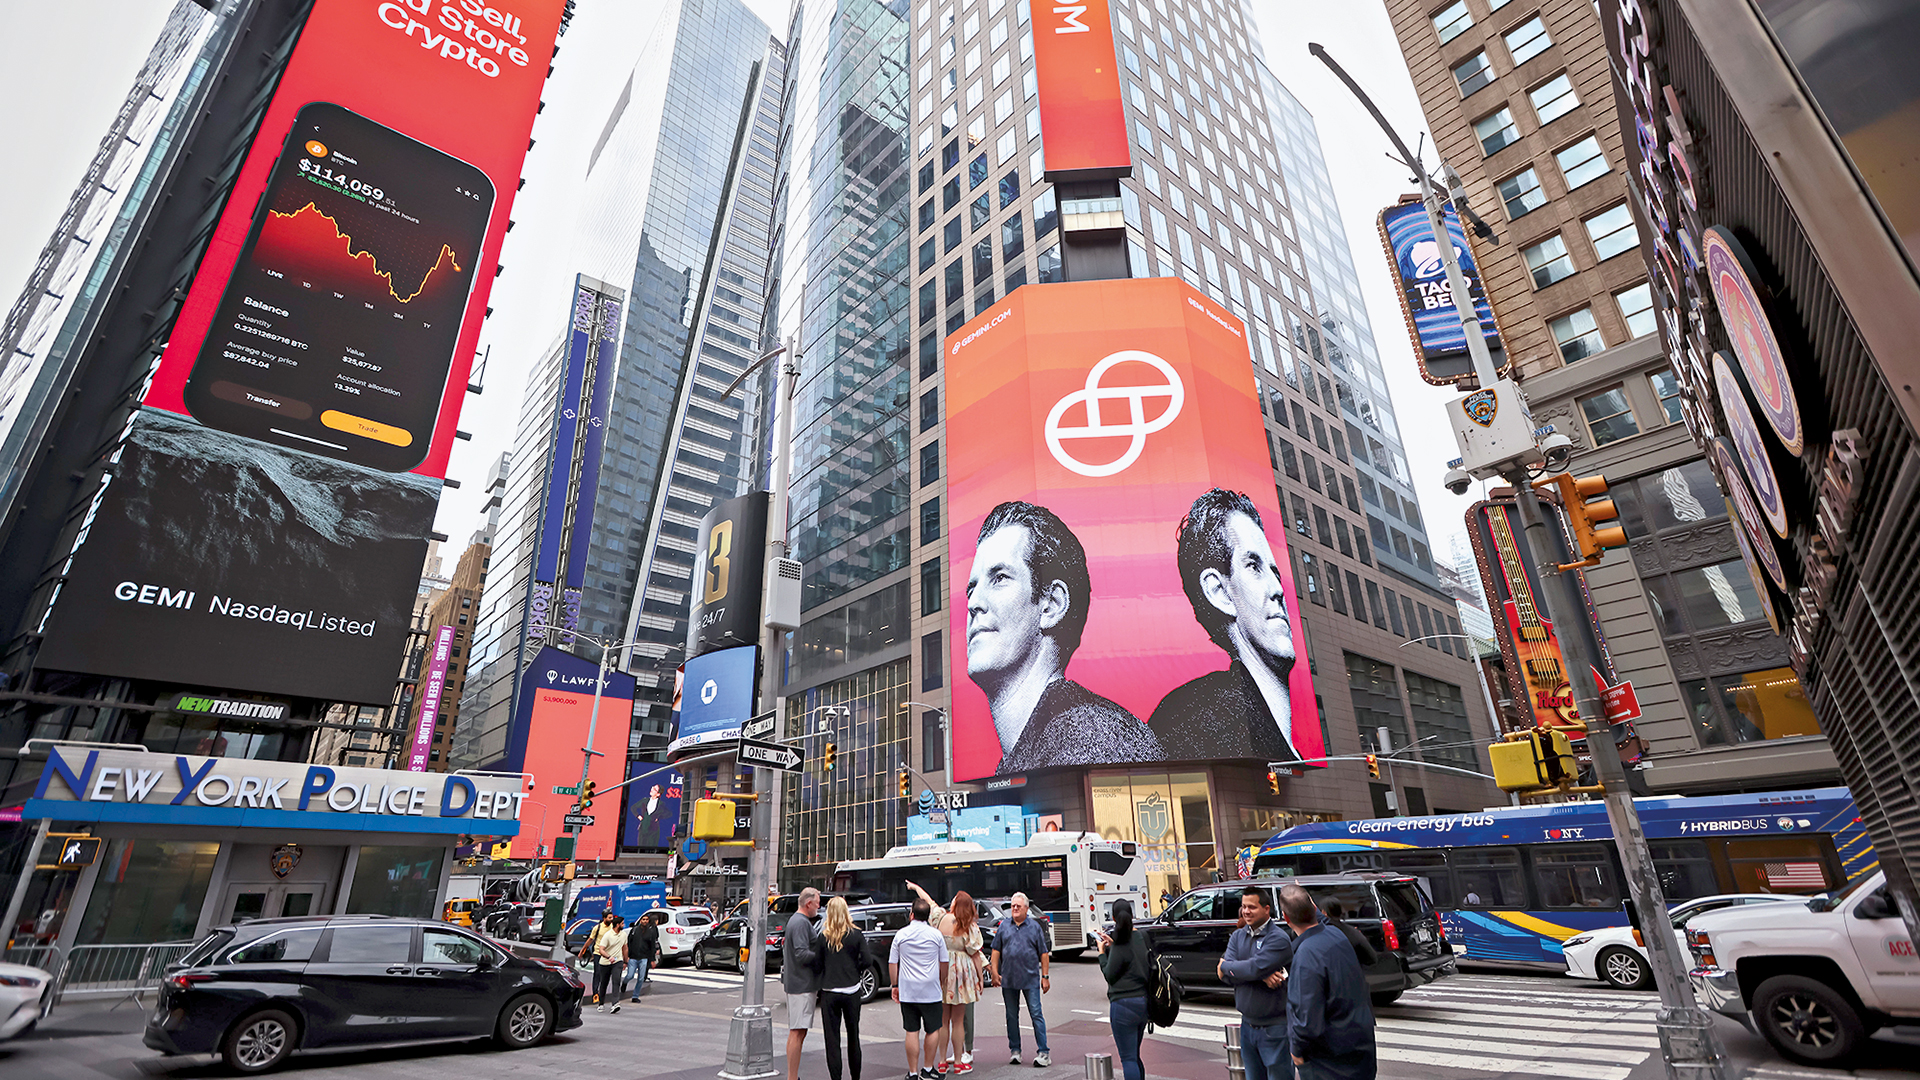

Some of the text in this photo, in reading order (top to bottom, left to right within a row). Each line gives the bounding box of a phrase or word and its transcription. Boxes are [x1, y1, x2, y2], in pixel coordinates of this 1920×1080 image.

[378, 2, 500, 77] Crypto
[438, 5, 529, 66] Store
[376, 202, 391, 214] past
[401, 212, 420, 225] hours
[267, 269, 284, 280] LIVE
[243, 296, 290, 319] Balance
[238, 313, 273, 330] Quantity
[961, 308, 1012, 347] GEMINI.COM
[226, 341, 298, 368] Average buy price
[291, 340, 309, 351] BTC
[345, 346, 366, 358] Value
[336, 373, 401, 398] Account allocation
[245, 392, 281, 409] Transfer
[357, 423, 379, 434] Trade
[1534, 424, 1555, 437] NYPD
[114, 581, 377, 638] GEMI NasdaqListed
[529, 583, 554, 639] ROKU
[702, 607, 726, 629] 24/7
[435, 629, 452, 662] MILLIONS
[427, 681, 441, 699] SEEN
[425, 699, 436, 710] BY
[1536, 691, 1574, 709] Hard
[417, 710, 434, 745] MILLIONS
[721, 730, 741, 739] CHAS
[746, 719, 773, 737] ONE WAY
[748, 747, 796, 765] ONE WAY
[33, 745, 529, 820] NEW YORK POLICE DEPT
[1348, 812, 1495, 833] clean-energy bus
[1691, 818, 1768, 832] HYBRIDBUS
[696, 865, 739, 876] CHASE
